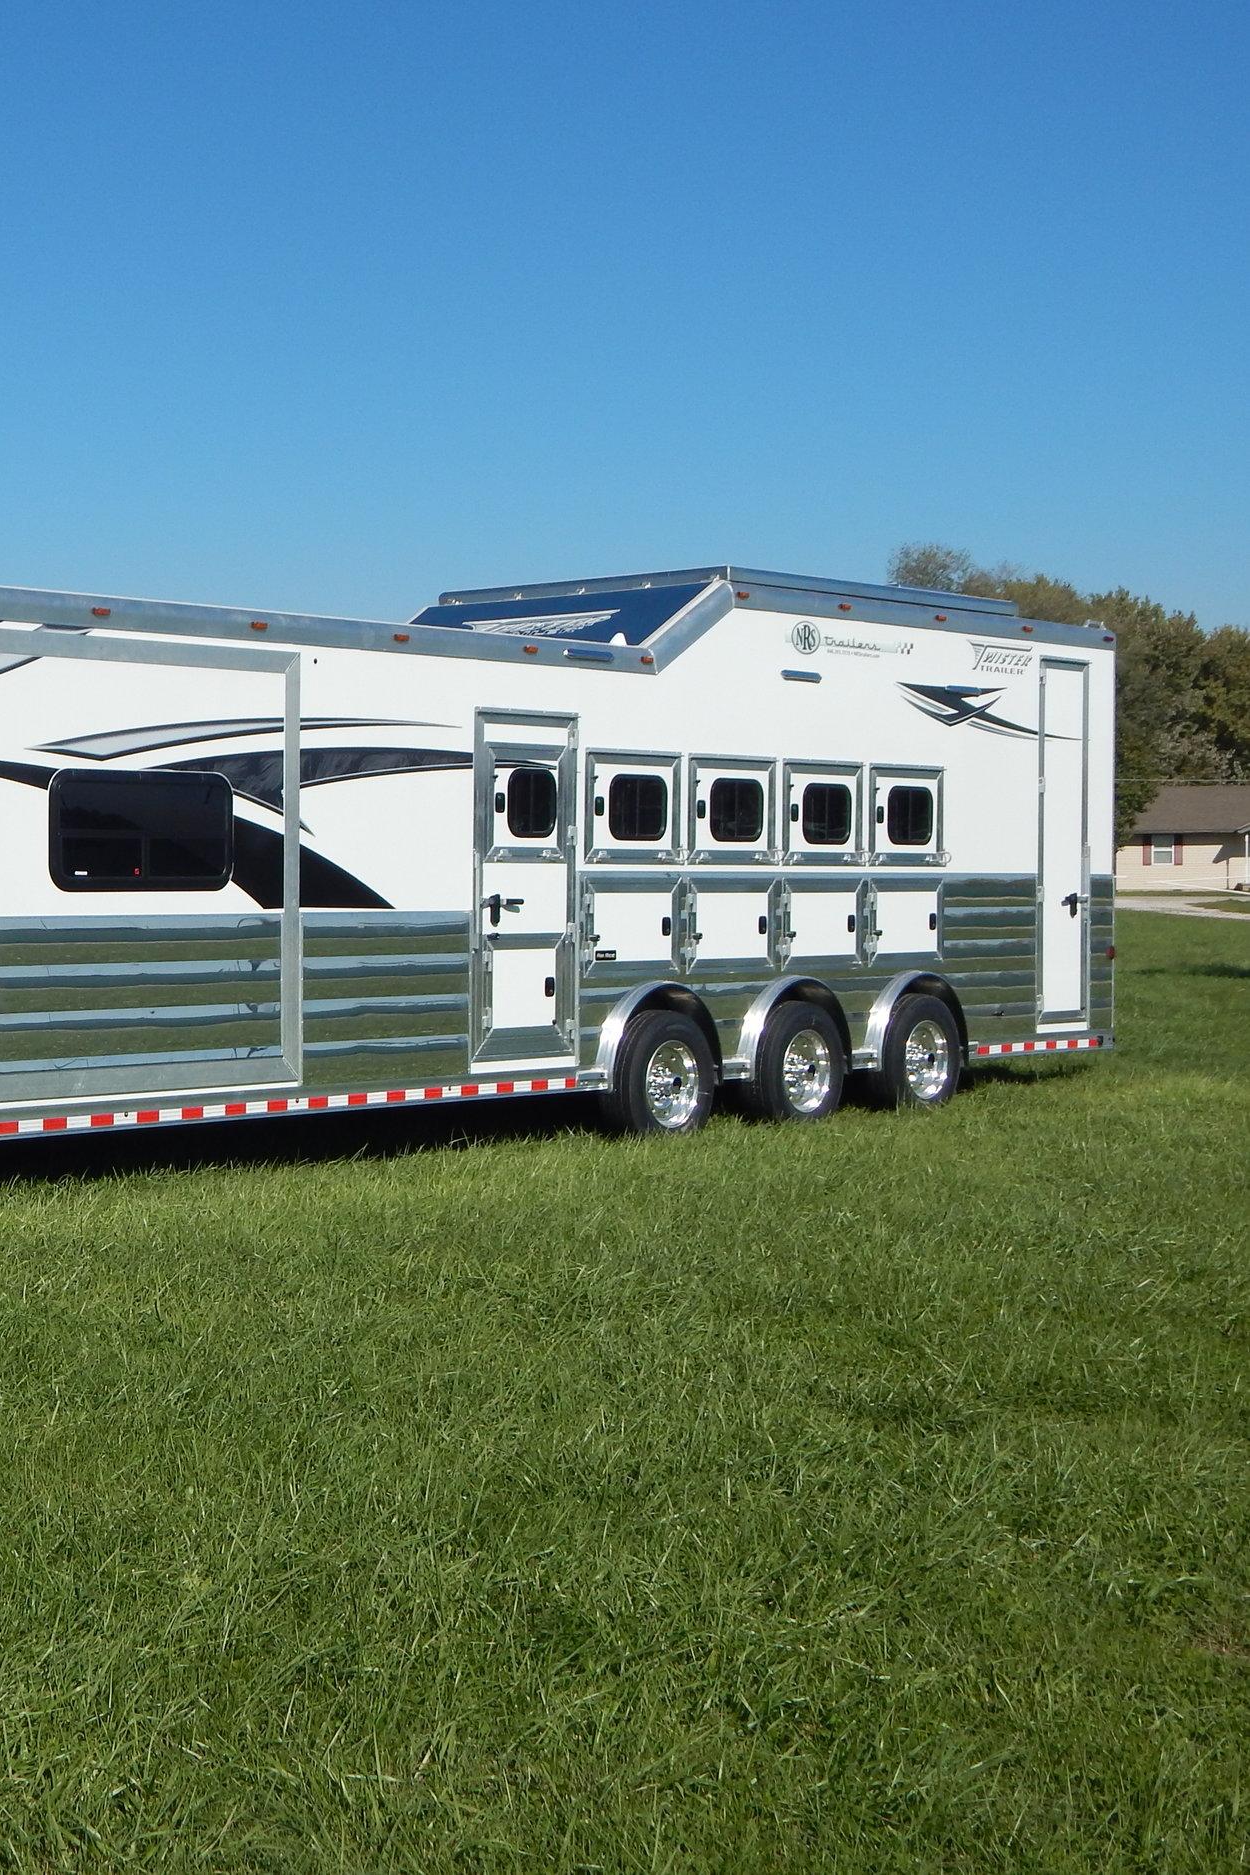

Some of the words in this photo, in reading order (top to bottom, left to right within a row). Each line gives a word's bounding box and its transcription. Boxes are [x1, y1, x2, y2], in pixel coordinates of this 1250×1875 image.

[795, 624, 817, 651] NRS
[966, 639, 1033, 671] TWISTER
[980, 665, 1024, 675] TRAILER
